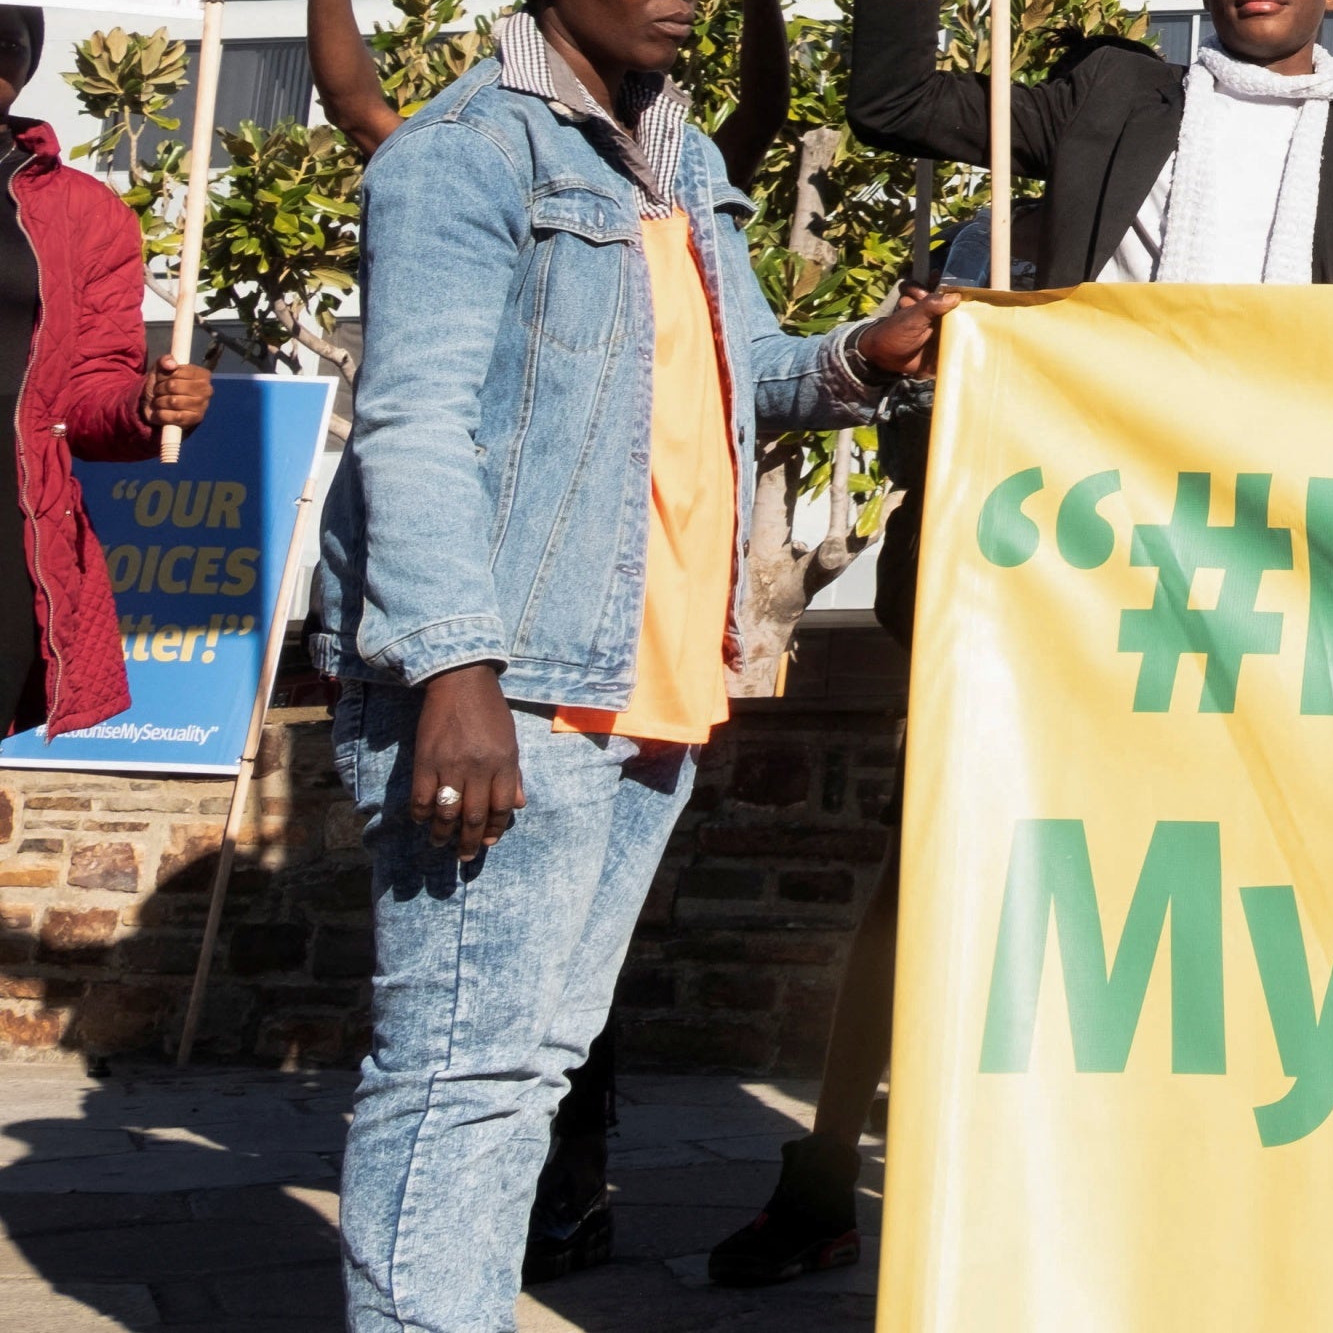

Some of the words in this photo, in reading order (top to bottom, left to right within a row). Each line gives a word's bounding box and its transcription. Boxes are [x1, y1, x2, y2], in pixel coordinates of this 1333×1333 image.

[113, 480, 246, 528] “OUR
[103, 546, 259, 595] OICES
[122, 616, 254, 663] tter!”
